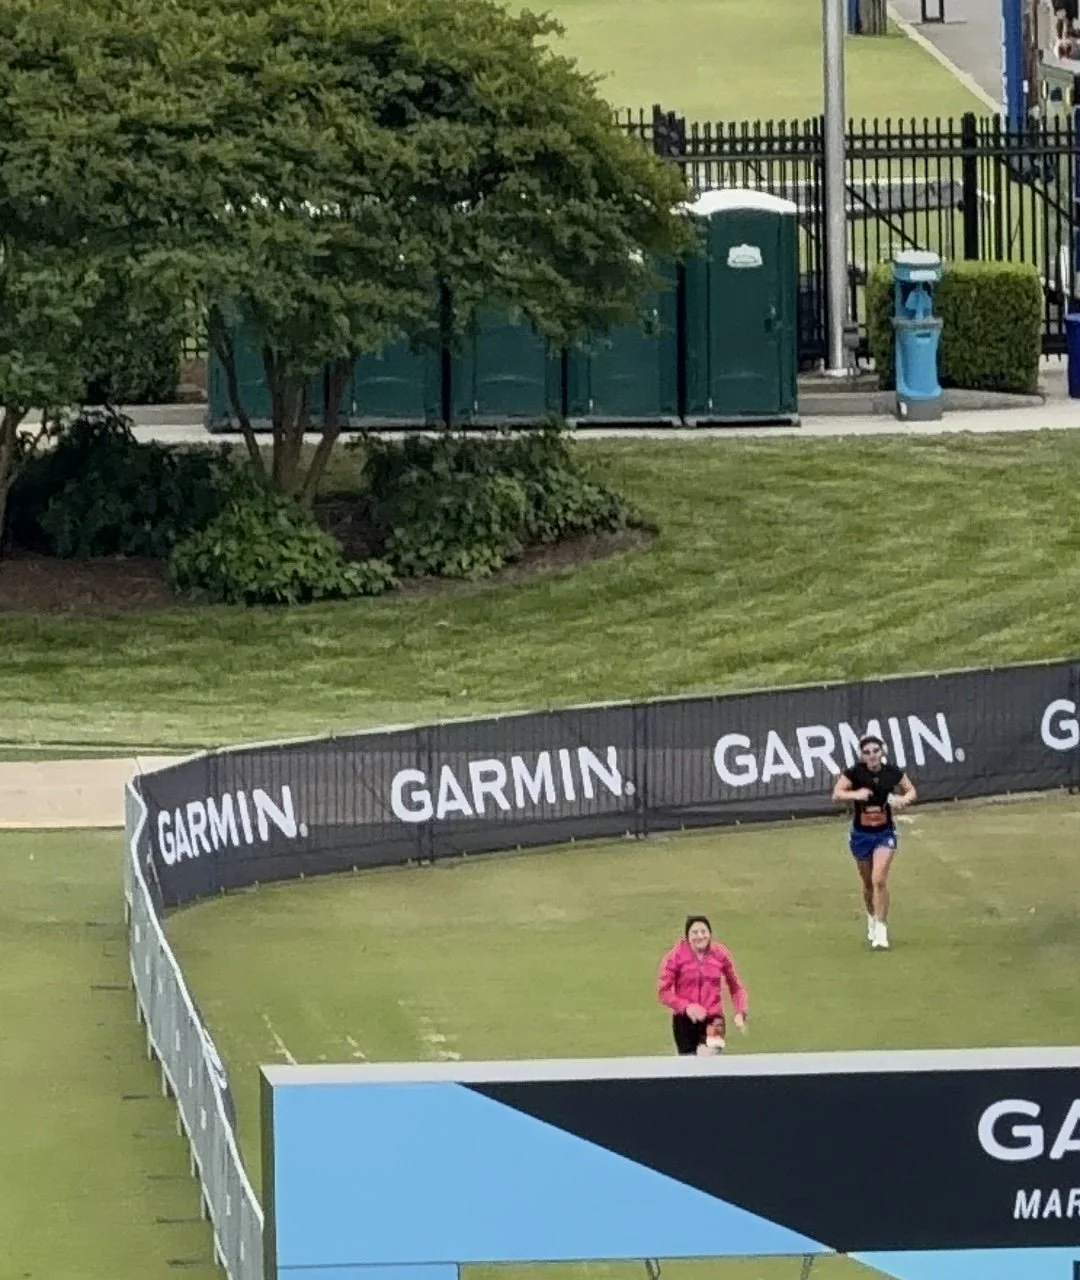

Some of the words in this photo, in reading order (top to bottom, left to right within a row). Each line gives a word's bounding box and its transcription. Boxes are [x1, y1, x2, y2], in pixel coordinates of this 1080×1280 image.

[391, 745, 624, 823] GARMIN
[714, 712, 955, 786] GARMIN
[158, 785, 297, 865] GARMIN
